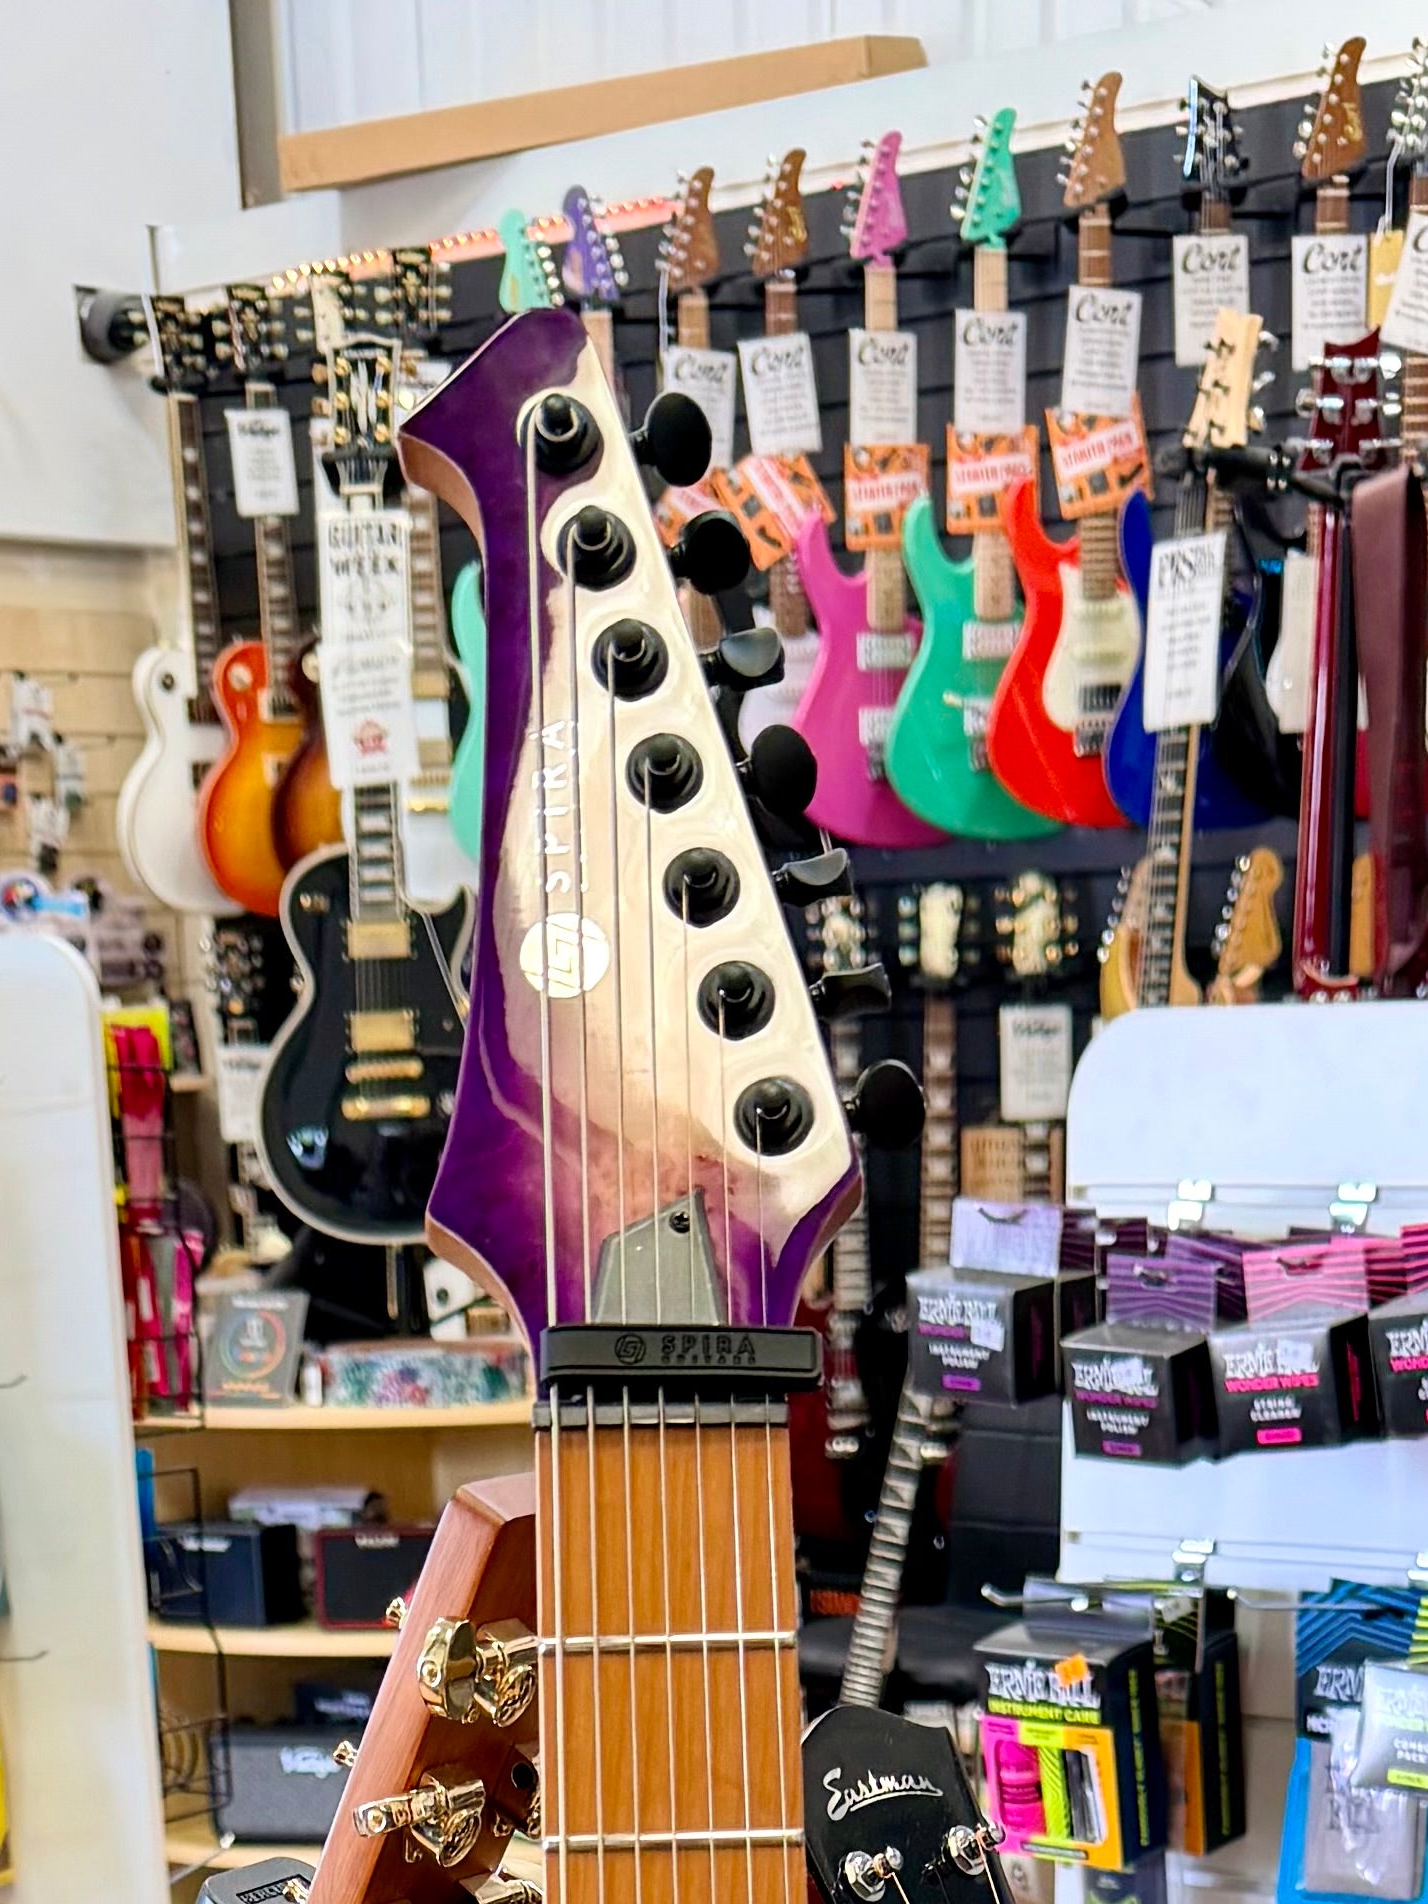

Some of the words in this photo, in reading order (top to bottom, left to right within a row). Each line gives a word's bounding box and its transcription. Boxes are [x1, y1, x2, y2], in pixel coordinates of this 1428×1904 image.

[1182, 243, 1240, 274] Cort
[1303, 243, 1364, 275] Cort
[1075, 293, 1133, 326] Cort
[660, 1332, 757, 1357] SPIRA
[1223, 1341, 1275, 1379] ERNIE
[1223, 1375, 1281, 1395] WONDER
[1280, 1372, 1320, 1390] WIPES
[984, 1657, 1049, 1705] ERNIE
[987, 1697, 1063, 1723] INSTRUMENT
[822, 1766, 944, 1822] Eastman
